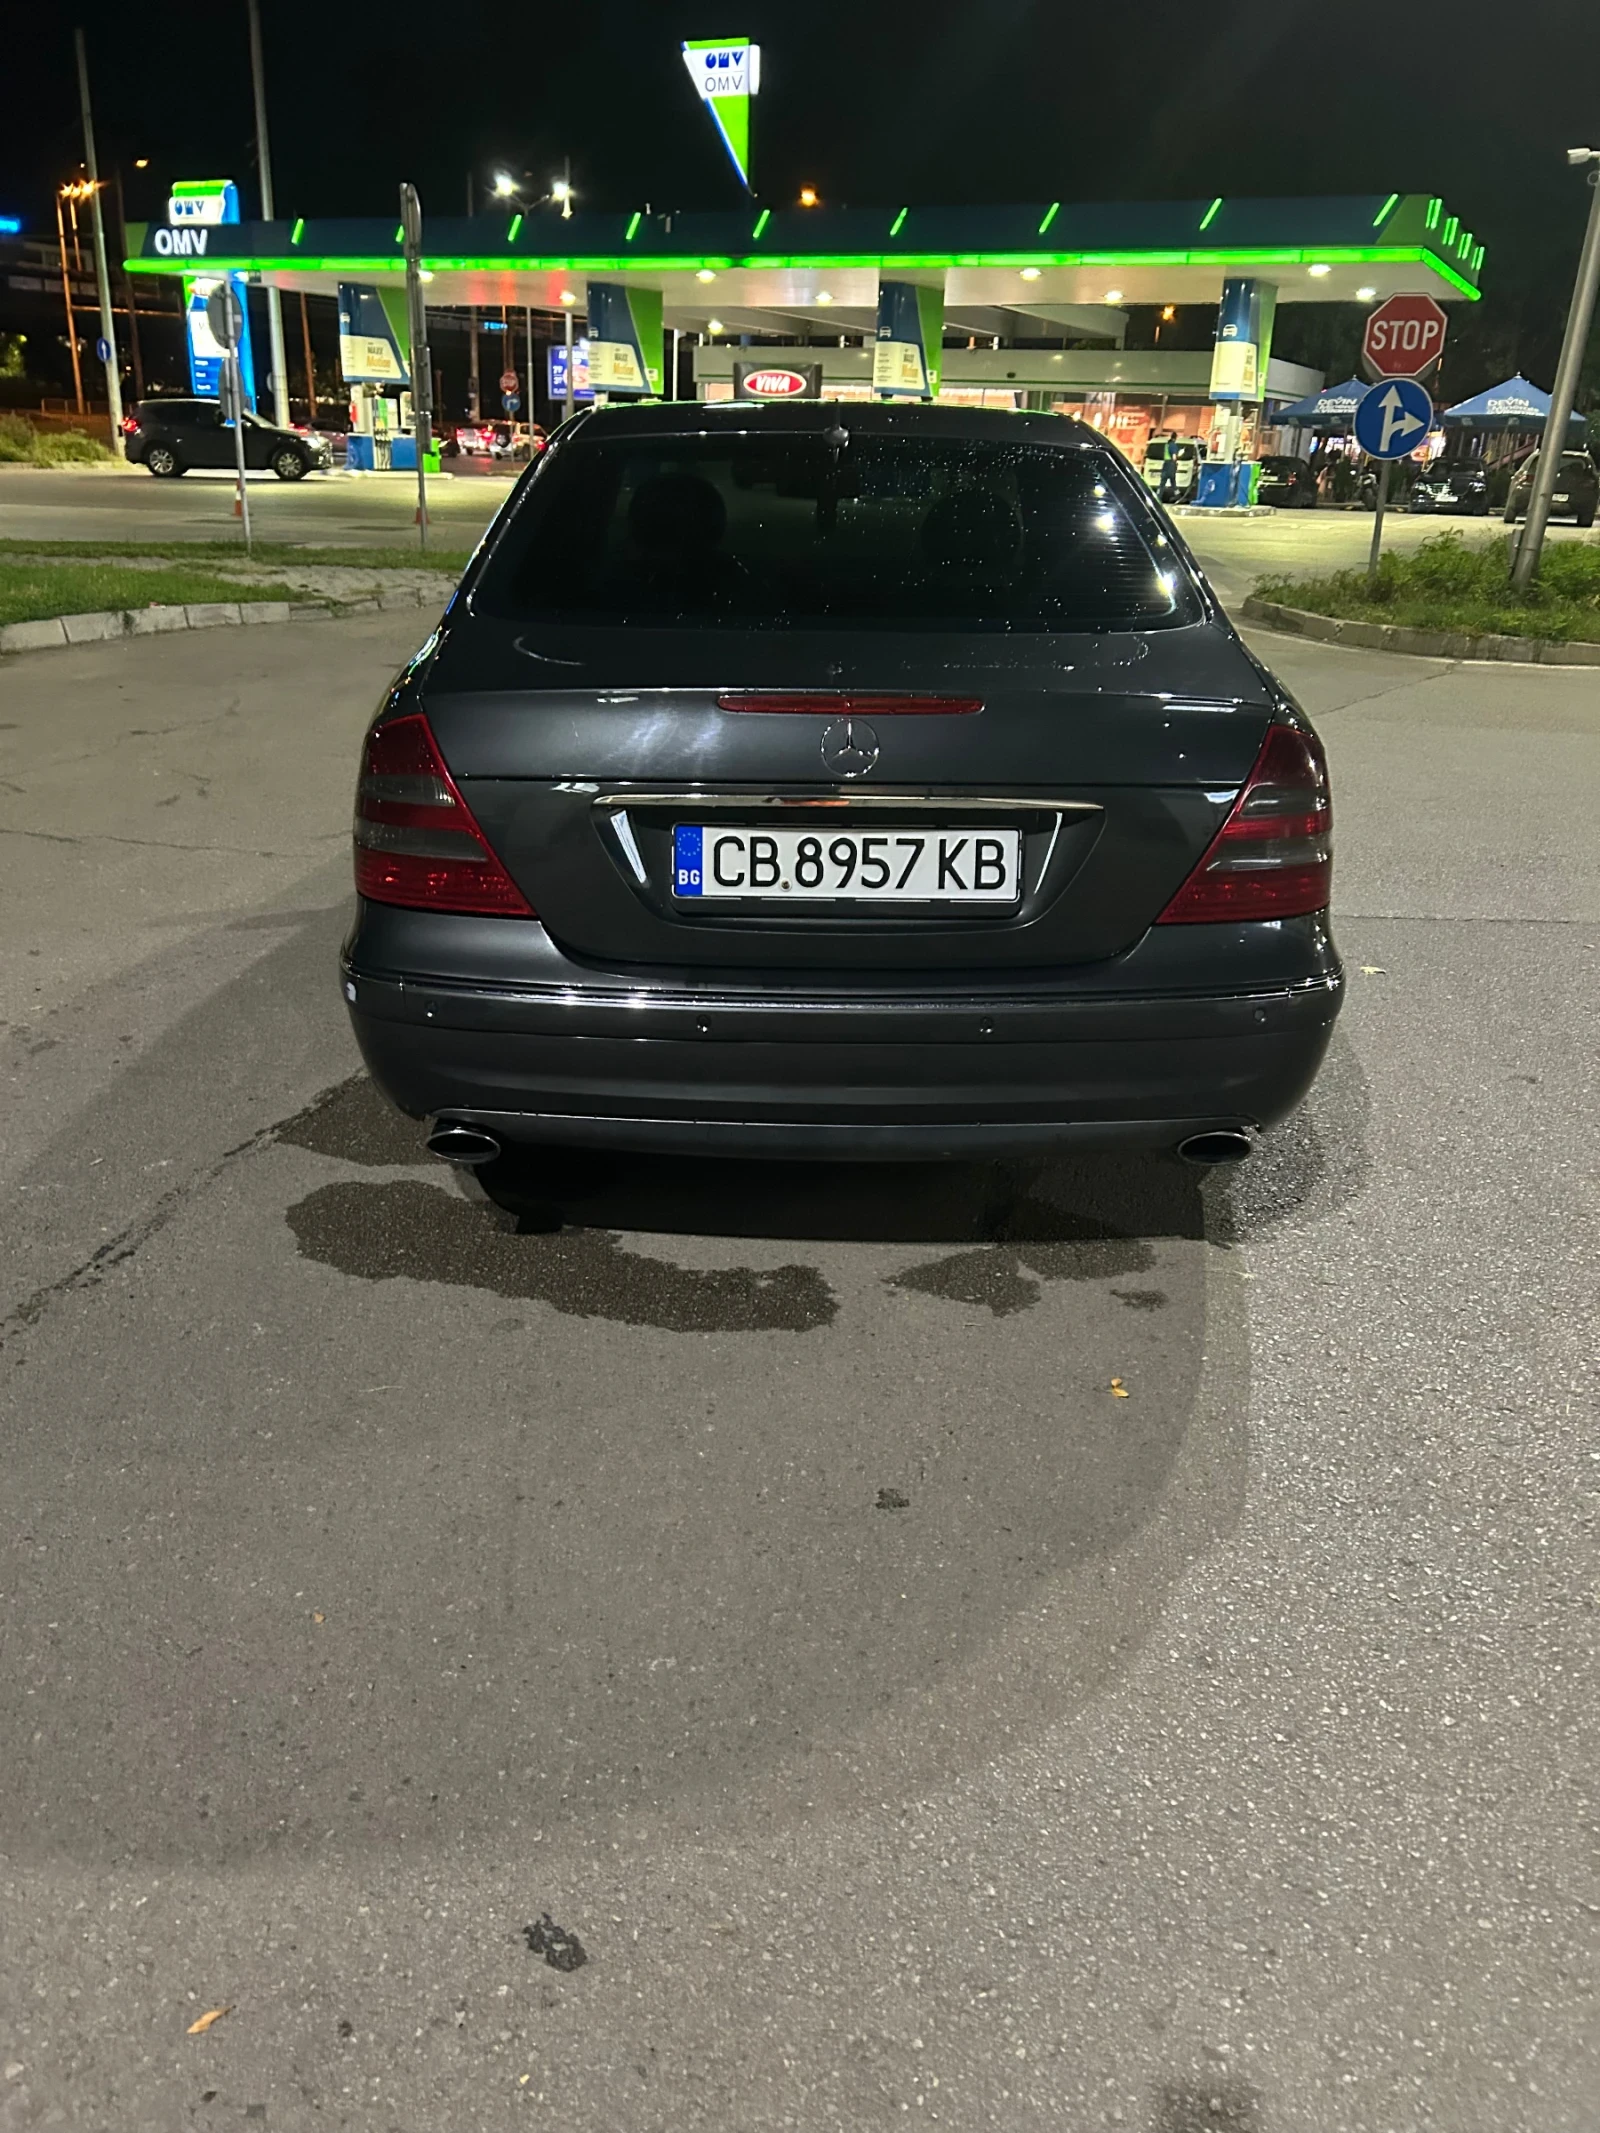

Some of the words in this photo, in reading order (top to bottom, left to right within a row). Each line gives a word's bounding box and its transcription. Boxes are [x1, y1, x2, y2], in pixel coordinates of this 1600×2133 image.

[705, 51, 744, 69] OMV
[705, 75, 743, 92] OMV
[154, 228, 208, 255] OMV
[1371, 320, 1439, 350] STOP
[756, 375, 790, 392] VIVA
[1318, 396, 1357, 405] DEVIN
[1487, 397, 1530, 407] DEVIN
[713, 836, 781, 888] CB
[795, 837, 925, 889] 8957
[938, 838, 1006, 890] KB
[678, 869, 700, 885] BG
